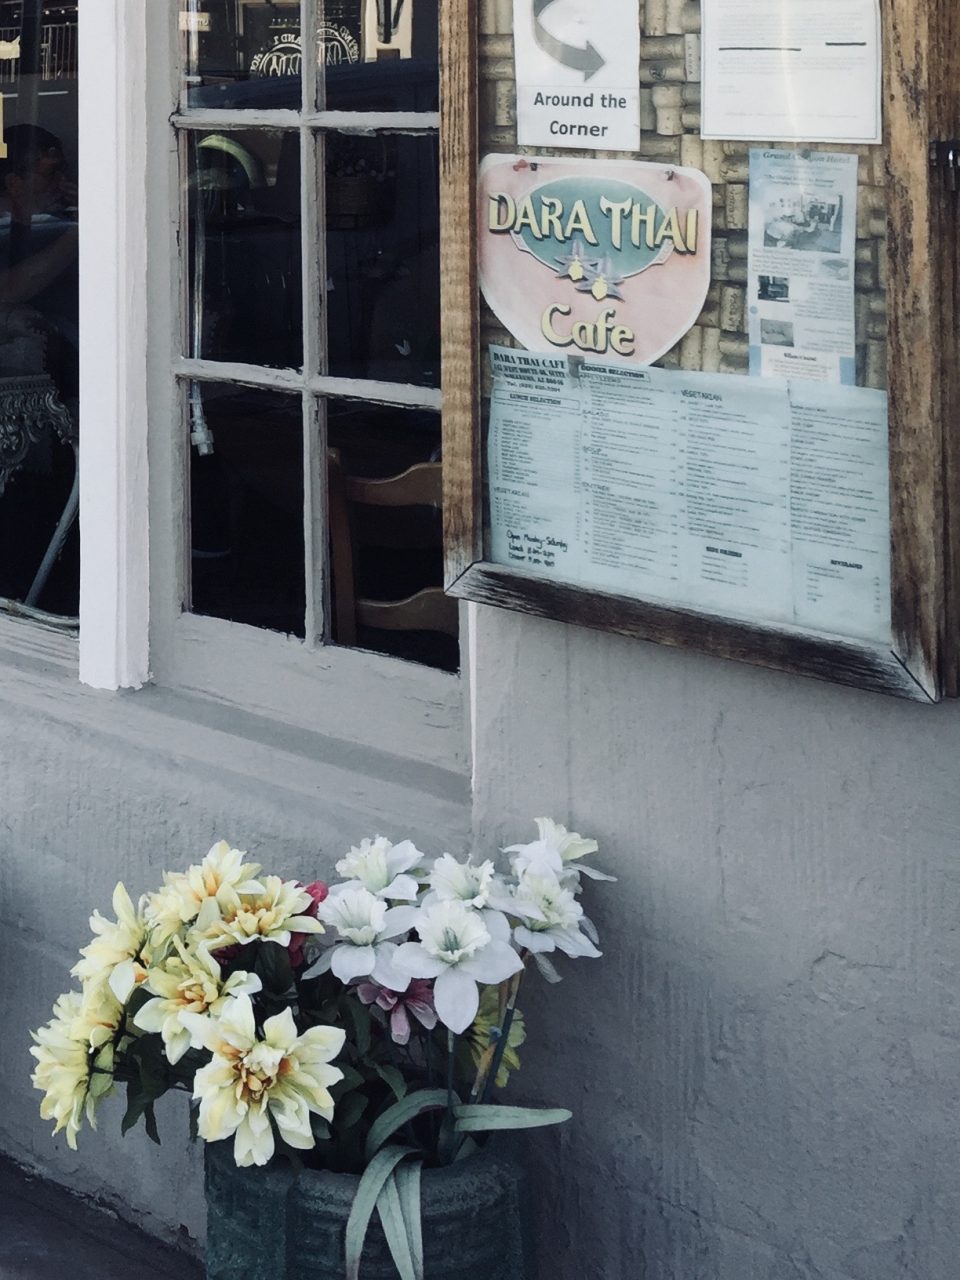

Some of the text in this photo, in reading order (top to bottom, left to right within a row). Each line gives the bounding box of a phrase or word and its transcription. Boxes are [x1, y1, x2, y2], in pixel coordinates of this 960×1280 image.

[534, 92, 627, 109] Around the
[550, 120, 608, 137] Corner
[489, 191, 699, 255] DARA THAI
[541, 303, 636, 356] Cafe
